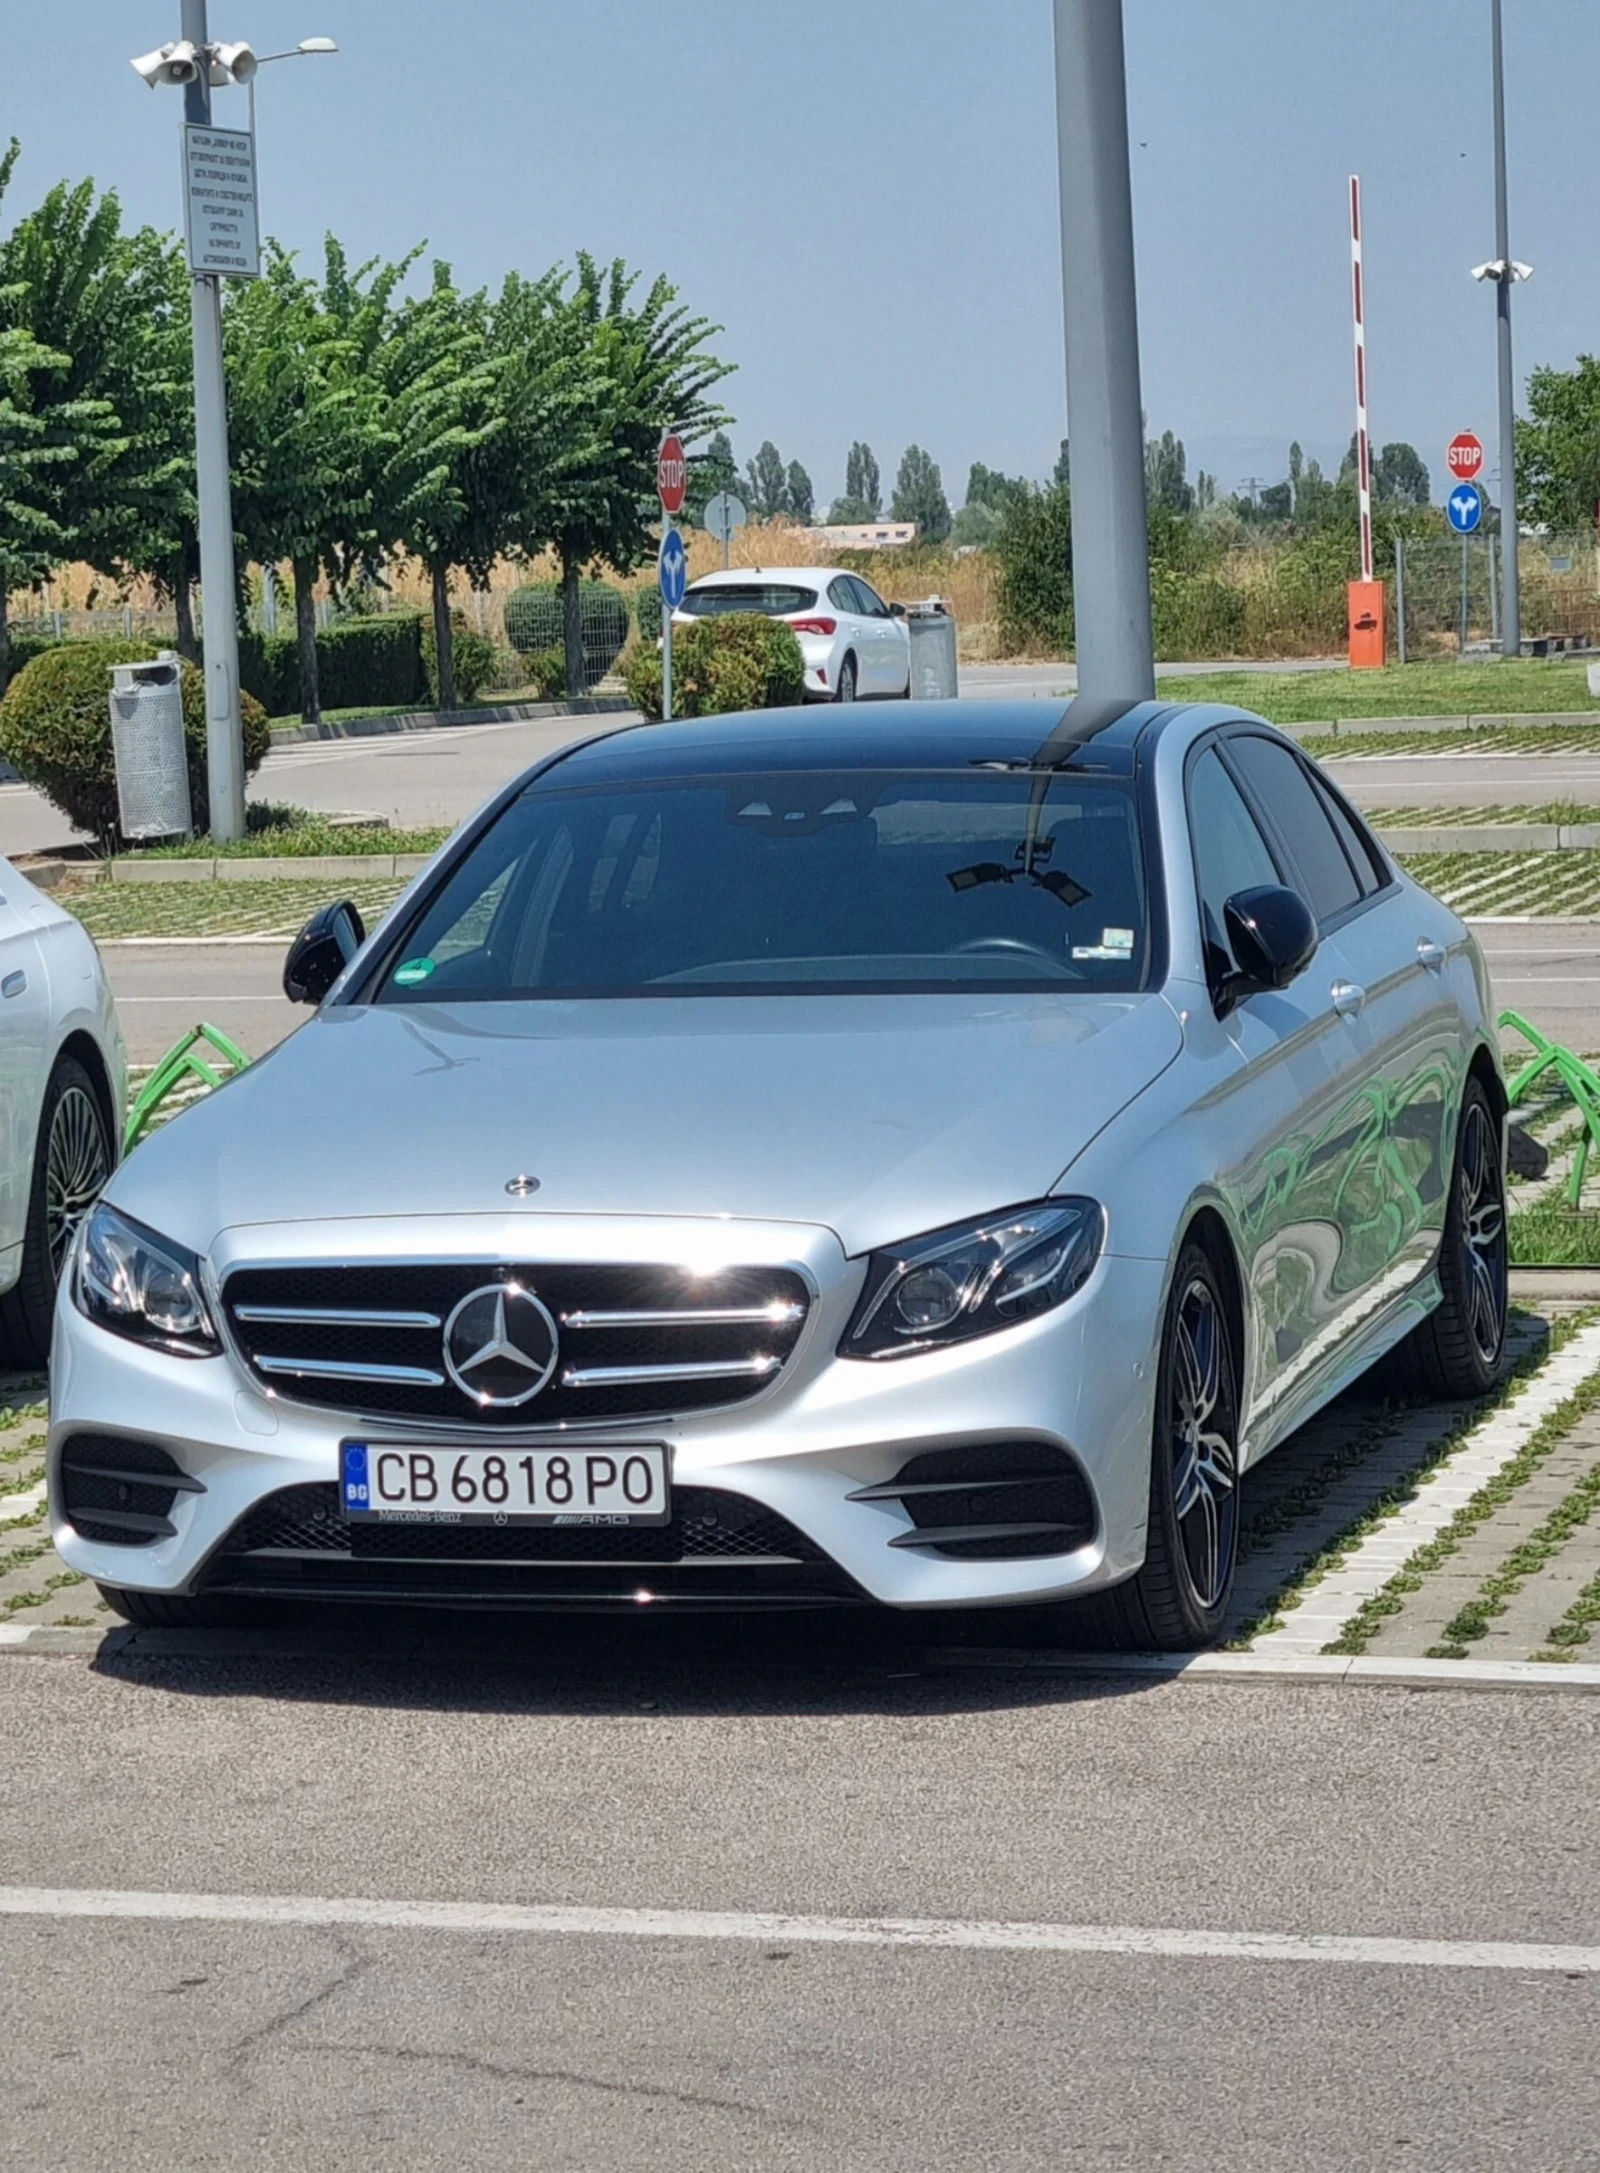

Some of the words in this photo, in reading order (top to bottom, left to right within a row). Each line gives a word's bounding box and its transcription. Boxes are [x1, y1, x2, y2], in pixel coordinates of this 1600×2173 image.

[1449, 446, 1481, 466] STOP
[660, 459, 684, 489] STOP
[377, 1453, 439, 1503] CB
[451, 1454, 575, 1506] 6818
[585, 1455, 654, 1506] PO
[346, 1483, 369, 1501] BG
[379, 1510, 462, 1523] Mercedes-Benz
[579, 1515, 630, 1525] AMG
